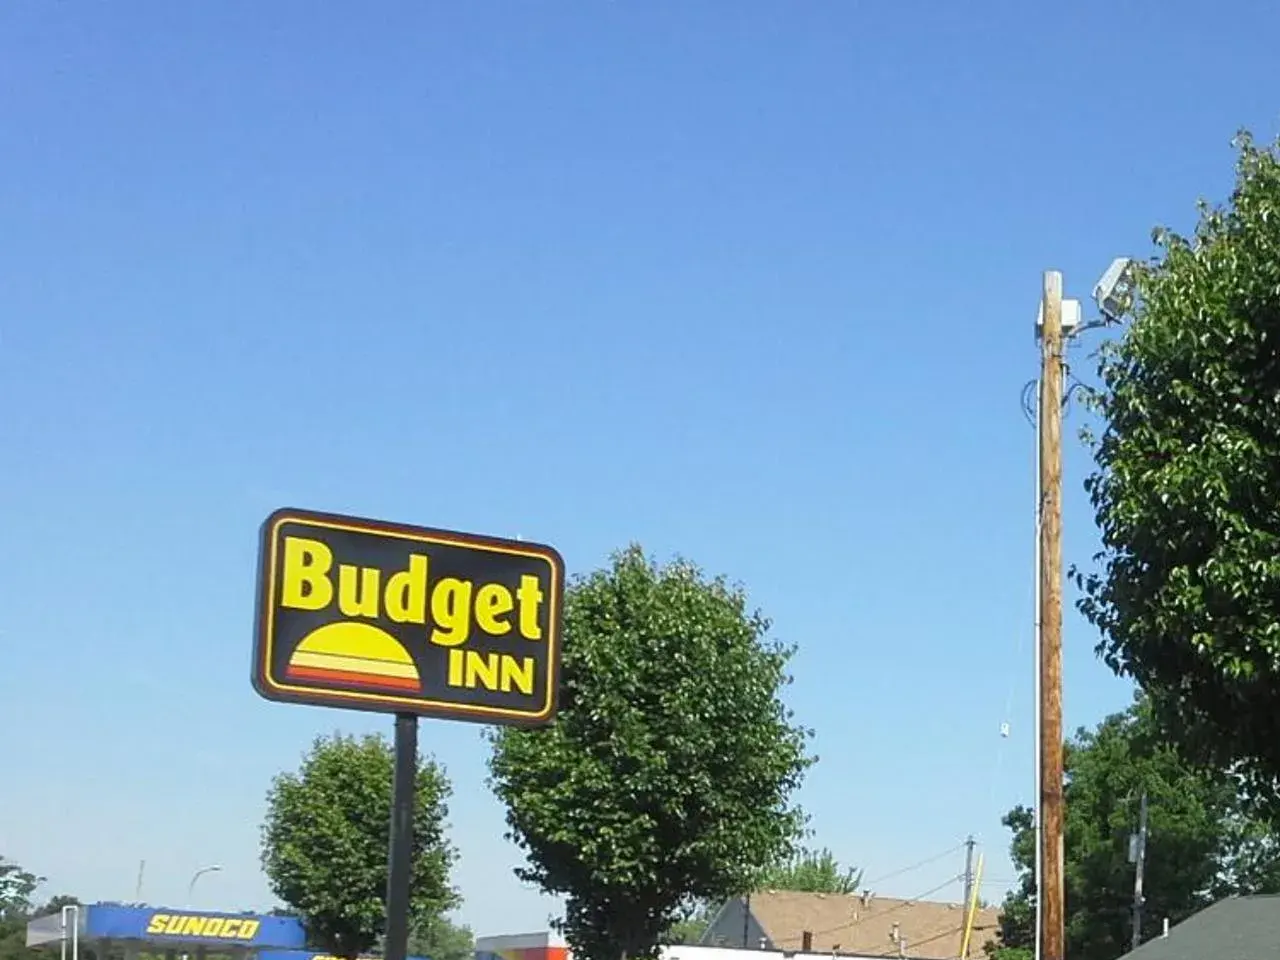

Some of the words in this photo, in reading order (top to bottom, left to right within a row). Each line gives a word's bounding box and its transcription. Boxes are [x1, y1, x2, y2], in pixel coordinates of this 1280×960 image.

[281, 535, 543, 647] Budget
[448, 649, 534, 695] INN
[146, 914, 260, 939] SUNOCO
